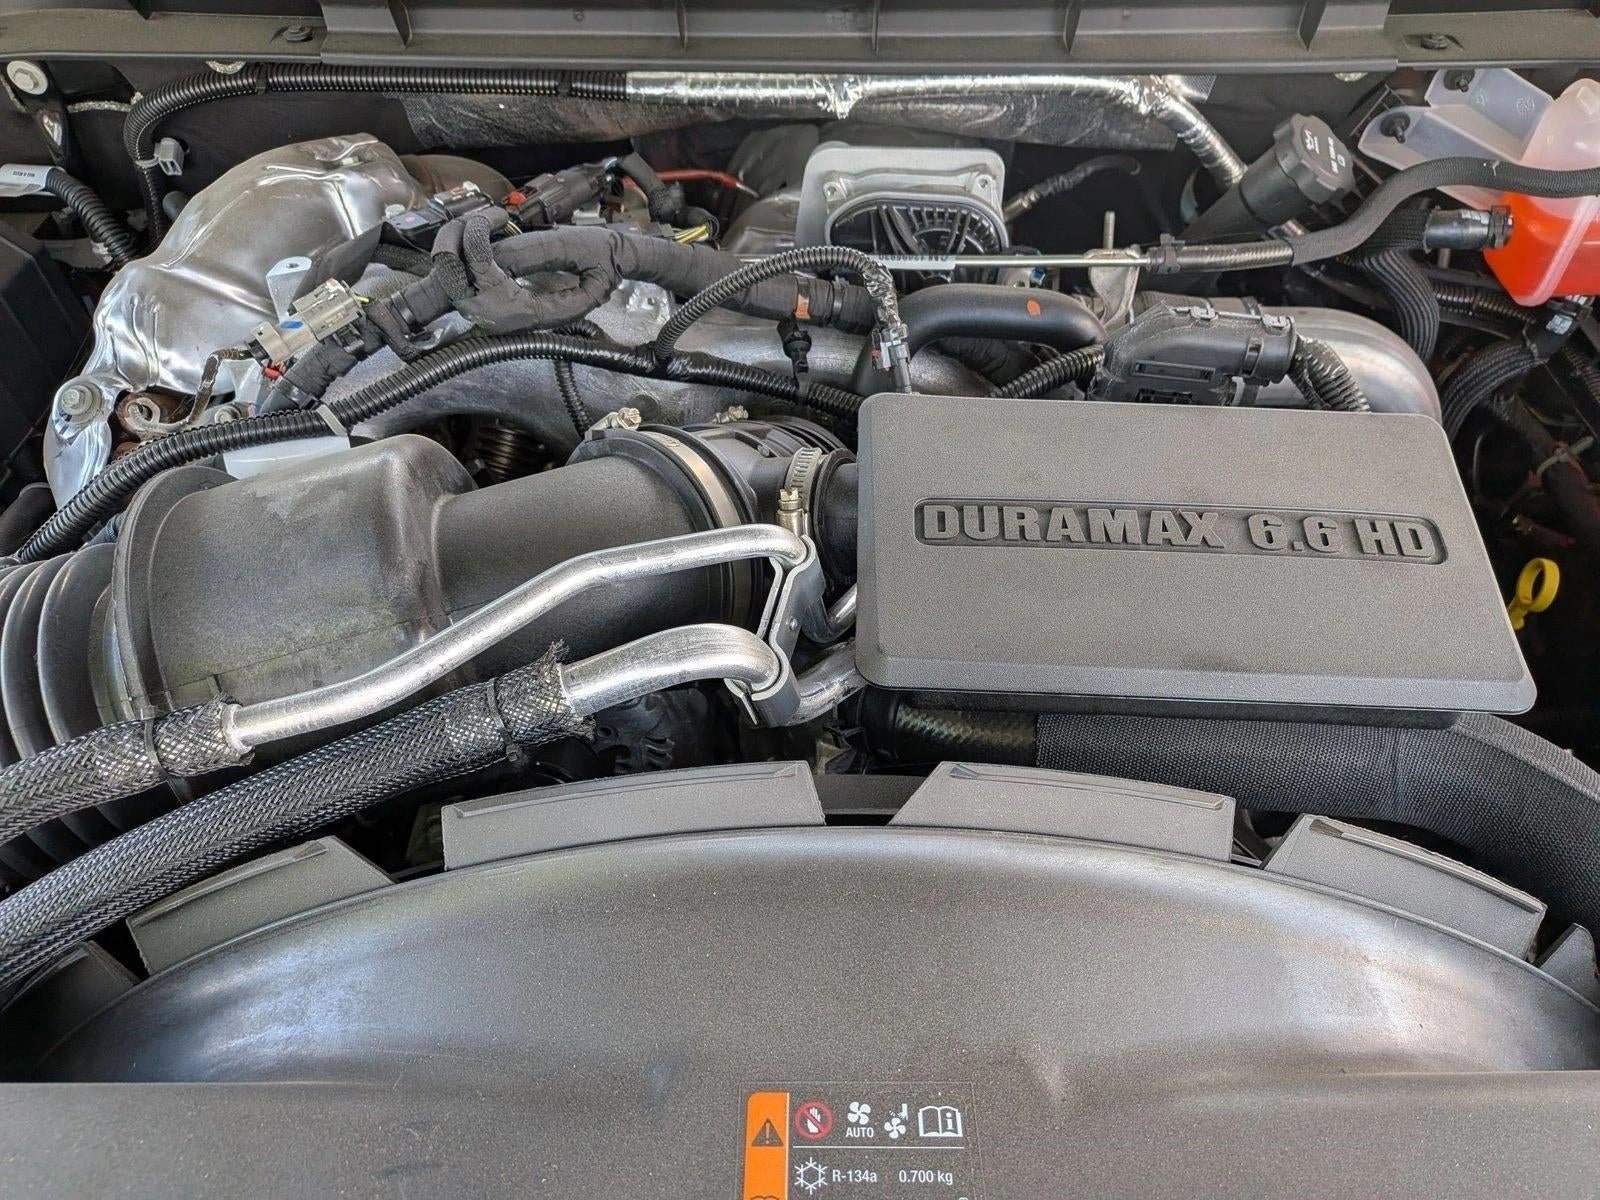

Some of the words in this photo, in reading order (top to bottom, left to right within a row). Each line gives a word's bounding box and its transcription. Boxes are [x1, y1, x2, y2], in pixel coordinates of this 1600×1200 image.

[923, 504, 1225, 549] DURAMAX
[1247, 513, 1344, 554] 6.6
[1353, 518, 1437, 558] HD
[846, 1127, 874, 1138] AUTO
[832, 1169, 878, 1183] R-134a
[899, 1169, 934, 1183] 0.700
[937, 1169, 954, 1186] kg
